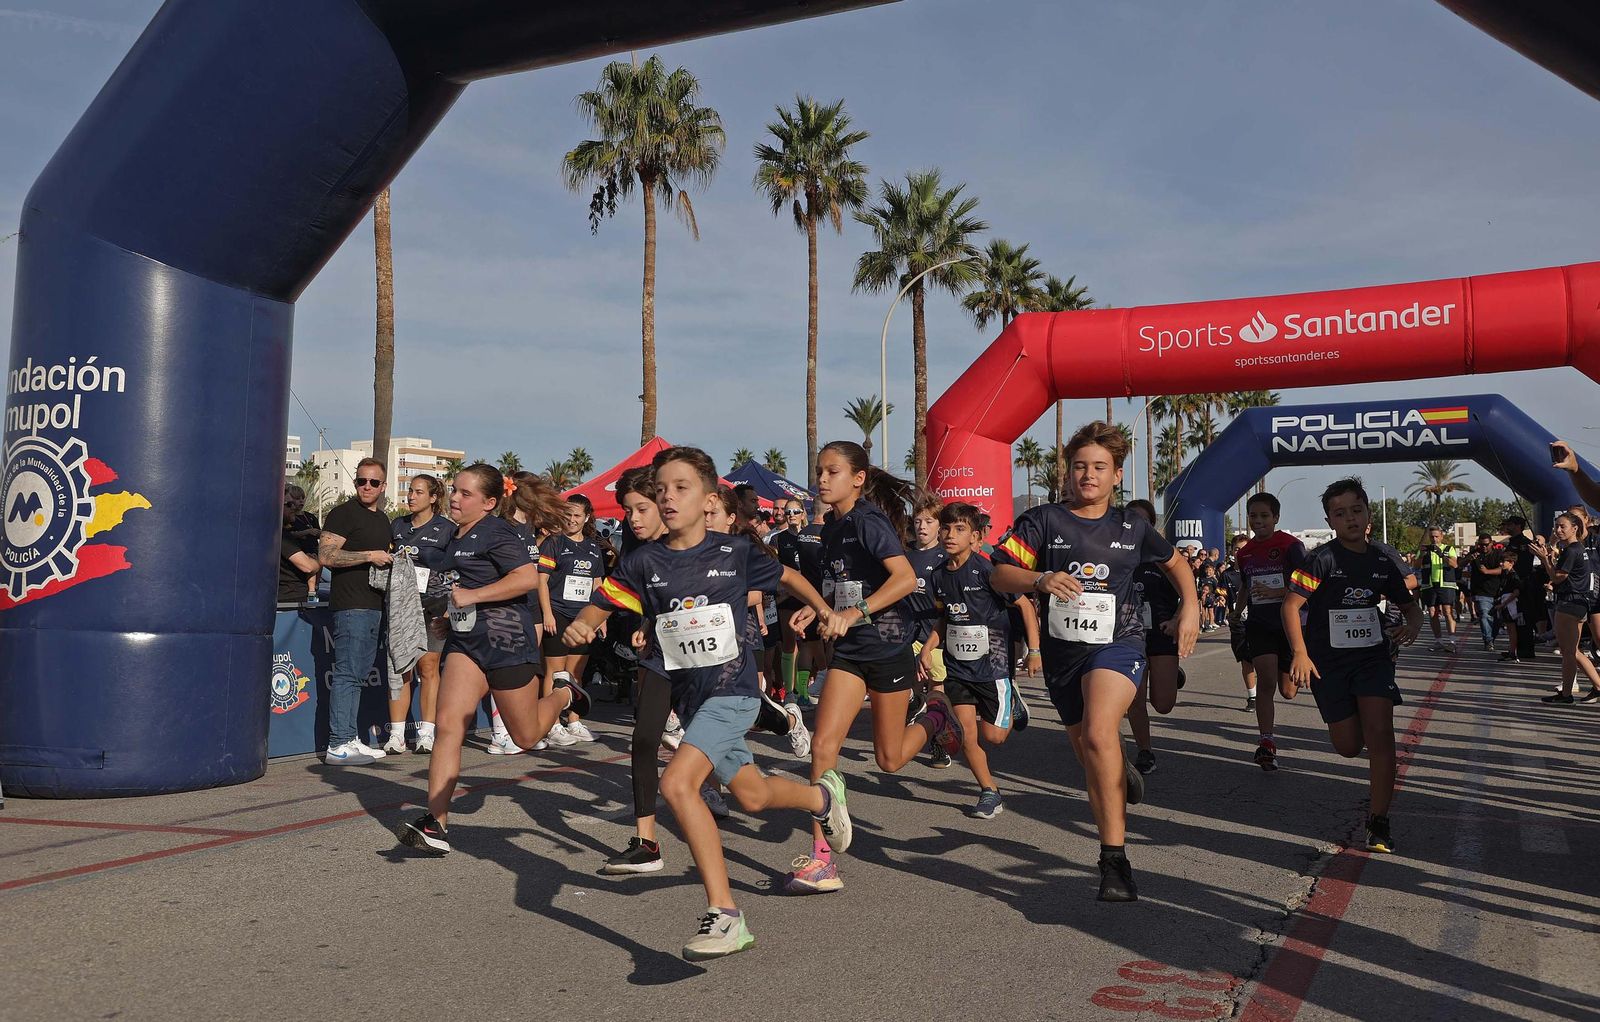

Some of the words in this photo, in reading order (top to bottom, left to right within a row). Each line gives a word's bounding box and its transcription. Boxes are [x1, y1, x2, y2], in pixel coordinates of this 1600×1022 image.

[1138, 322, 1234, 358] Sports
[1283, 302, 1456, 340] Santander
[1234, 350, 1341, 369] sportssantander.es
[5, 394, 82, 438] mupol
[1271, 427, 1470, 453] NACIONAL
[27, 457, 65, 492] Mutualidad
[936, 466, 975, 481] Sports
[935, 485, 995, 499] Santander
[1174, 518, 1204, 538] RUTA
[720, 569, 737, 577] mupol
[1068, 561, 1110, 580] 200
[575, 588, 586, 596] 158
[450, 611, 467, 622] 1020
[1063, 616, 1099, 632] 1144
[1344, 628, 1373, 639] 1095
[678, 636, 718, 655] 1113
[955, 643, 979, 653] 1122
